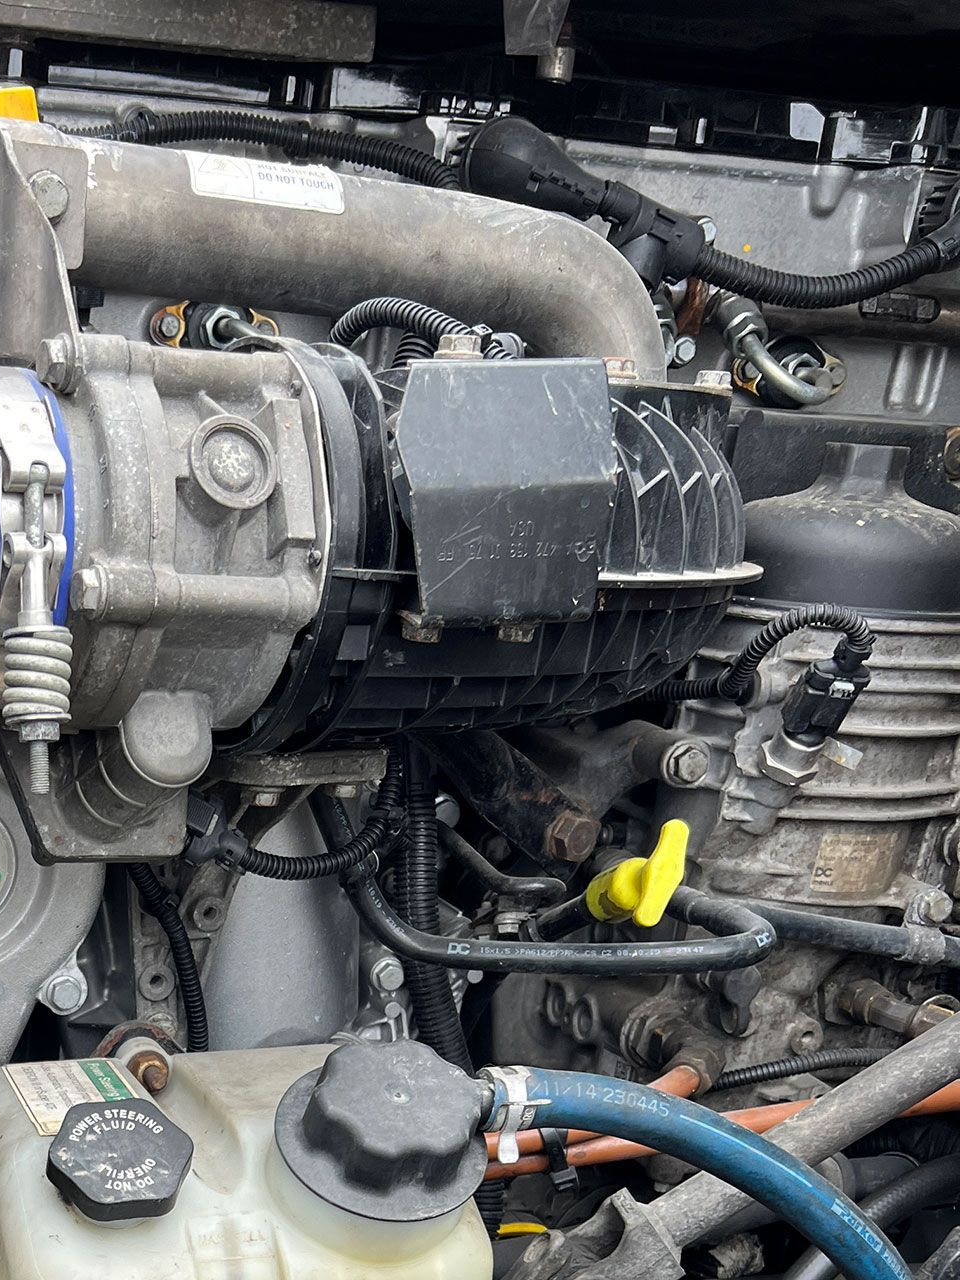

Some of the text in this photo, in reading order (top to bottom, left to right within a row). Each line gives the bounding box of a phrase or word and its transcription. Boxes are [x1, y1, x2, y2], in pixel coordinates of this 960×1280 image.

[257, 171, 335, 191] DO NOT TOUCH
[447, 942, 471, 956] DC
[69, 1109, 163, 1142] POWER STEERING
[93, 1120, 136, 1135] FLUID
[96, 1158, 157, 1179] OVERFILL
[104, 1175, 155, 1192] DO NOT
[831, 1198, 884, 1253] Parker
